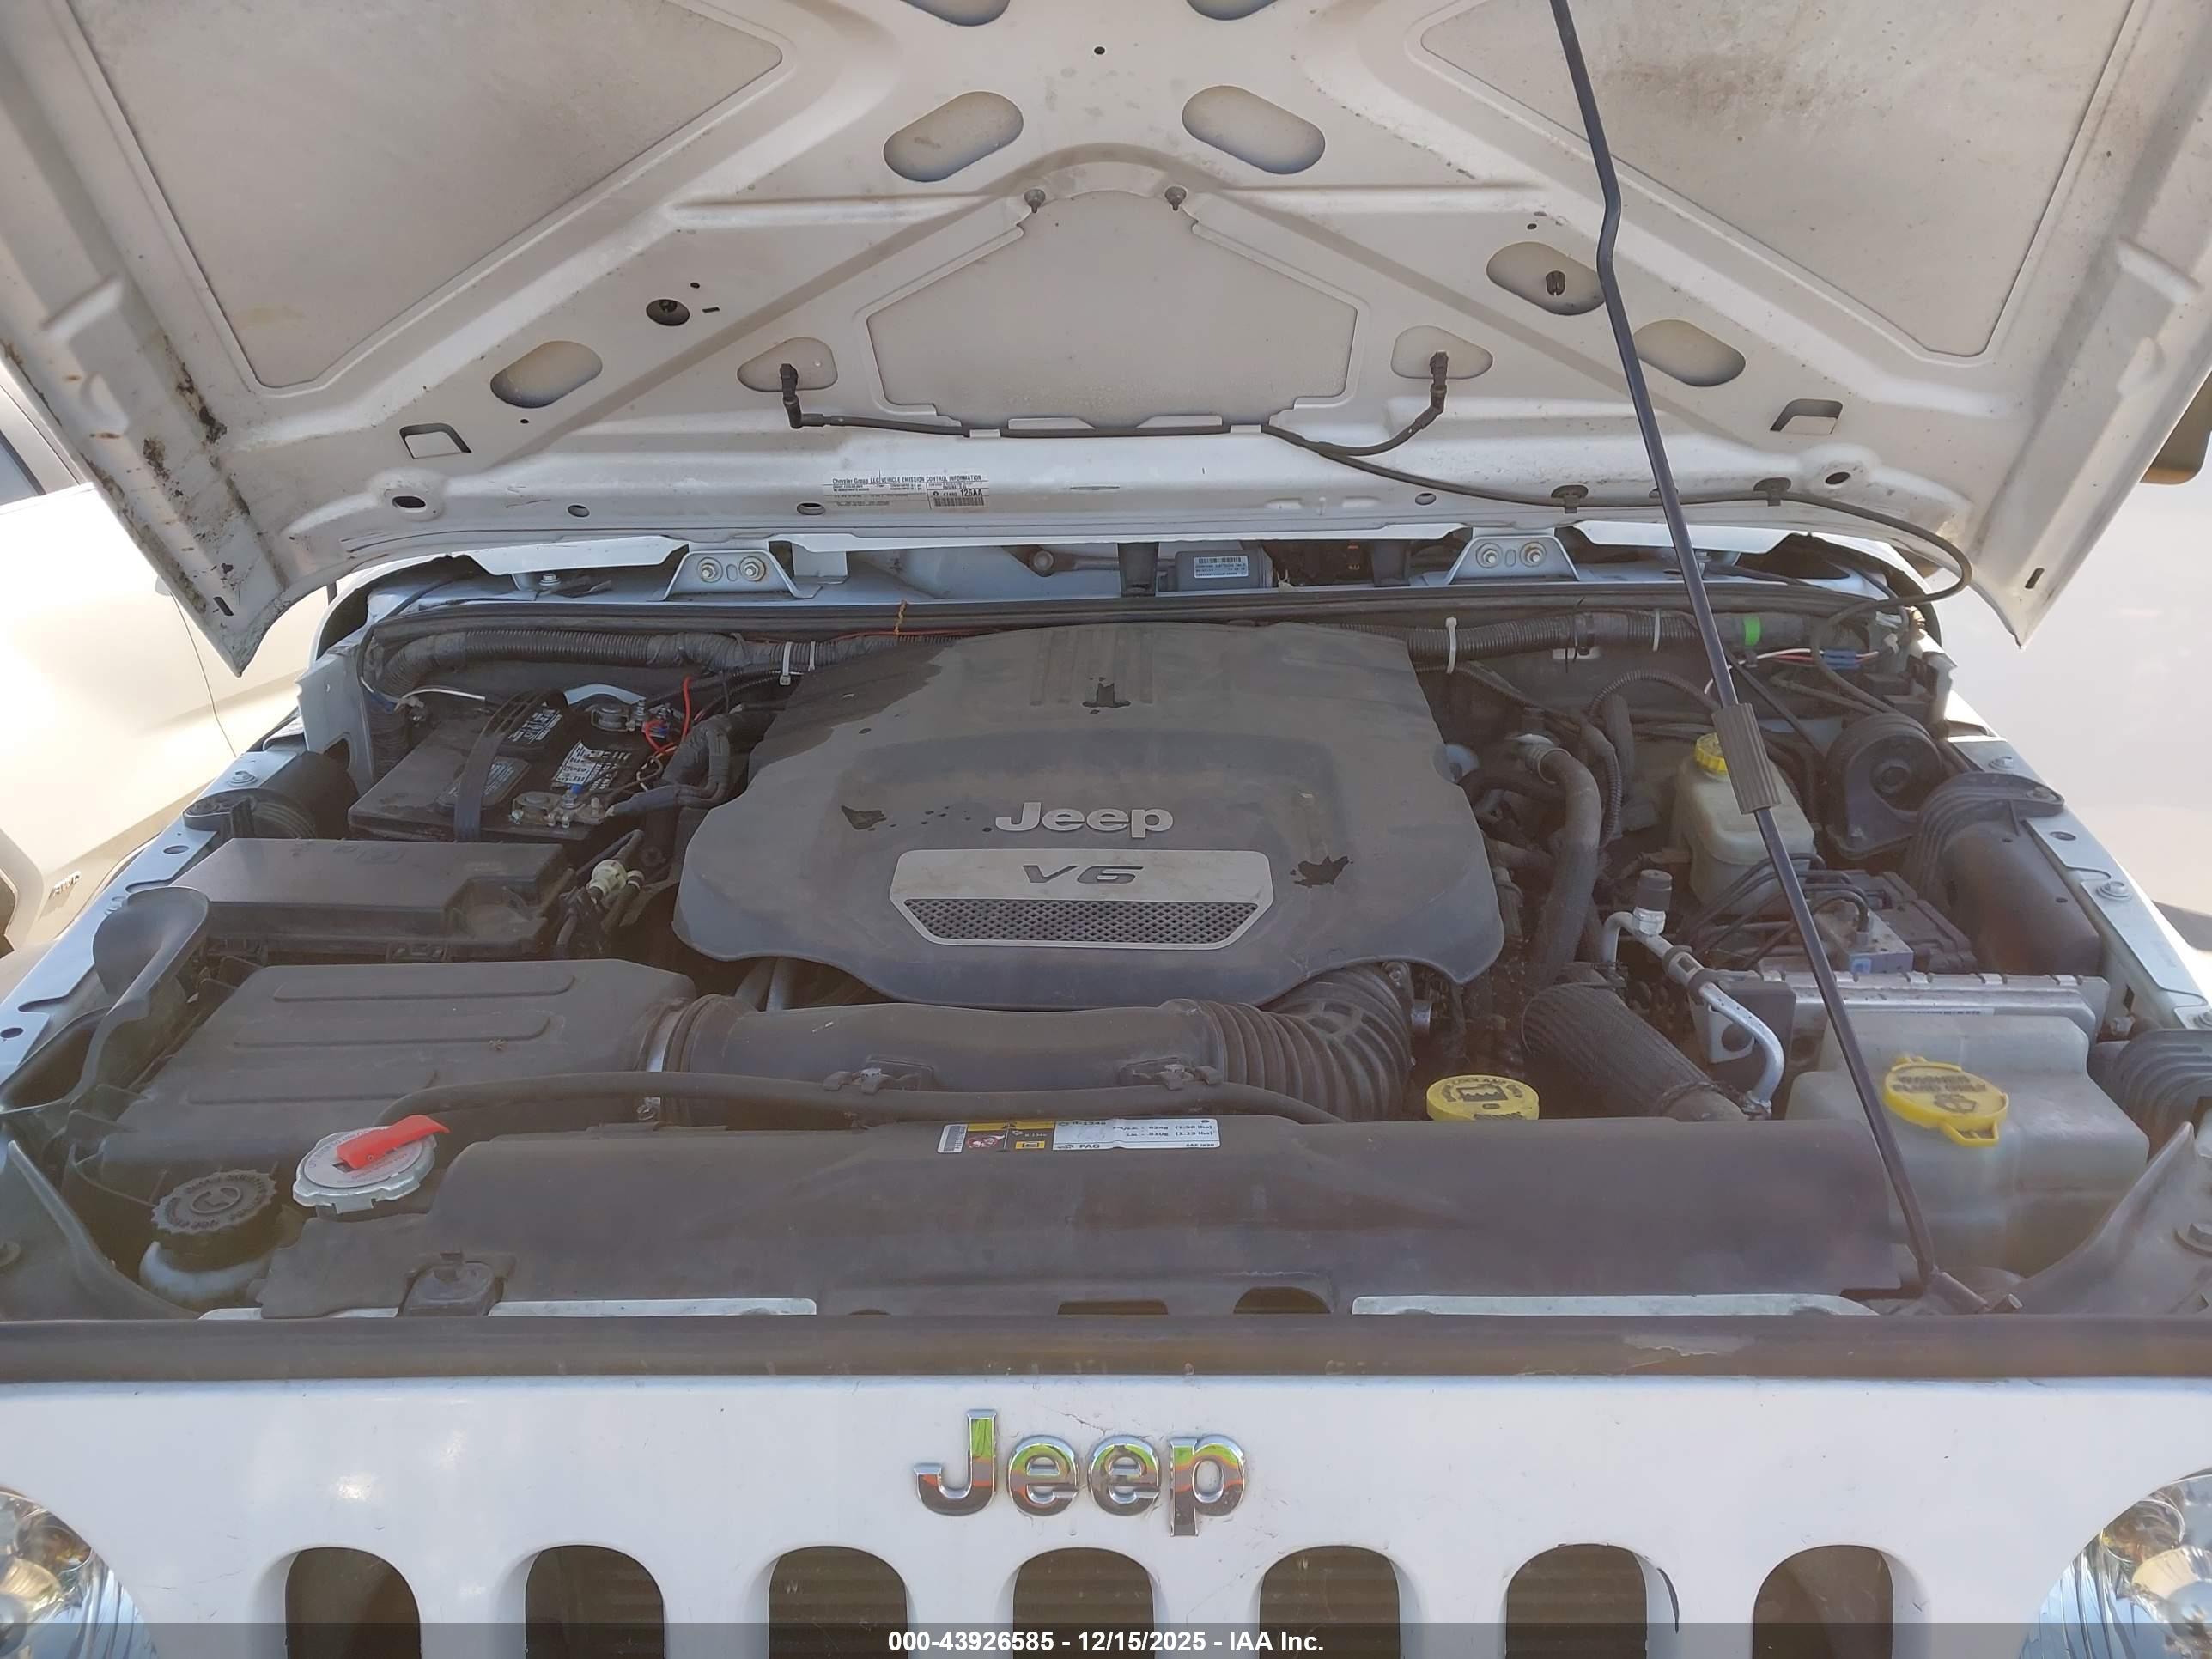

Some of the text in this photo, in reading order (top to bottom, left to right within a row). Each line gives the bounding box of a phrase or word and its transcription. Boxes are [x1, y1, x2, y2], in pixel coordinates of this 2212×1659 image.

[995, 801, 1173, 838] Jeep
[1022, 865, 1144, 884] V6
[913, 1408, 1248, 1537] Jeep
